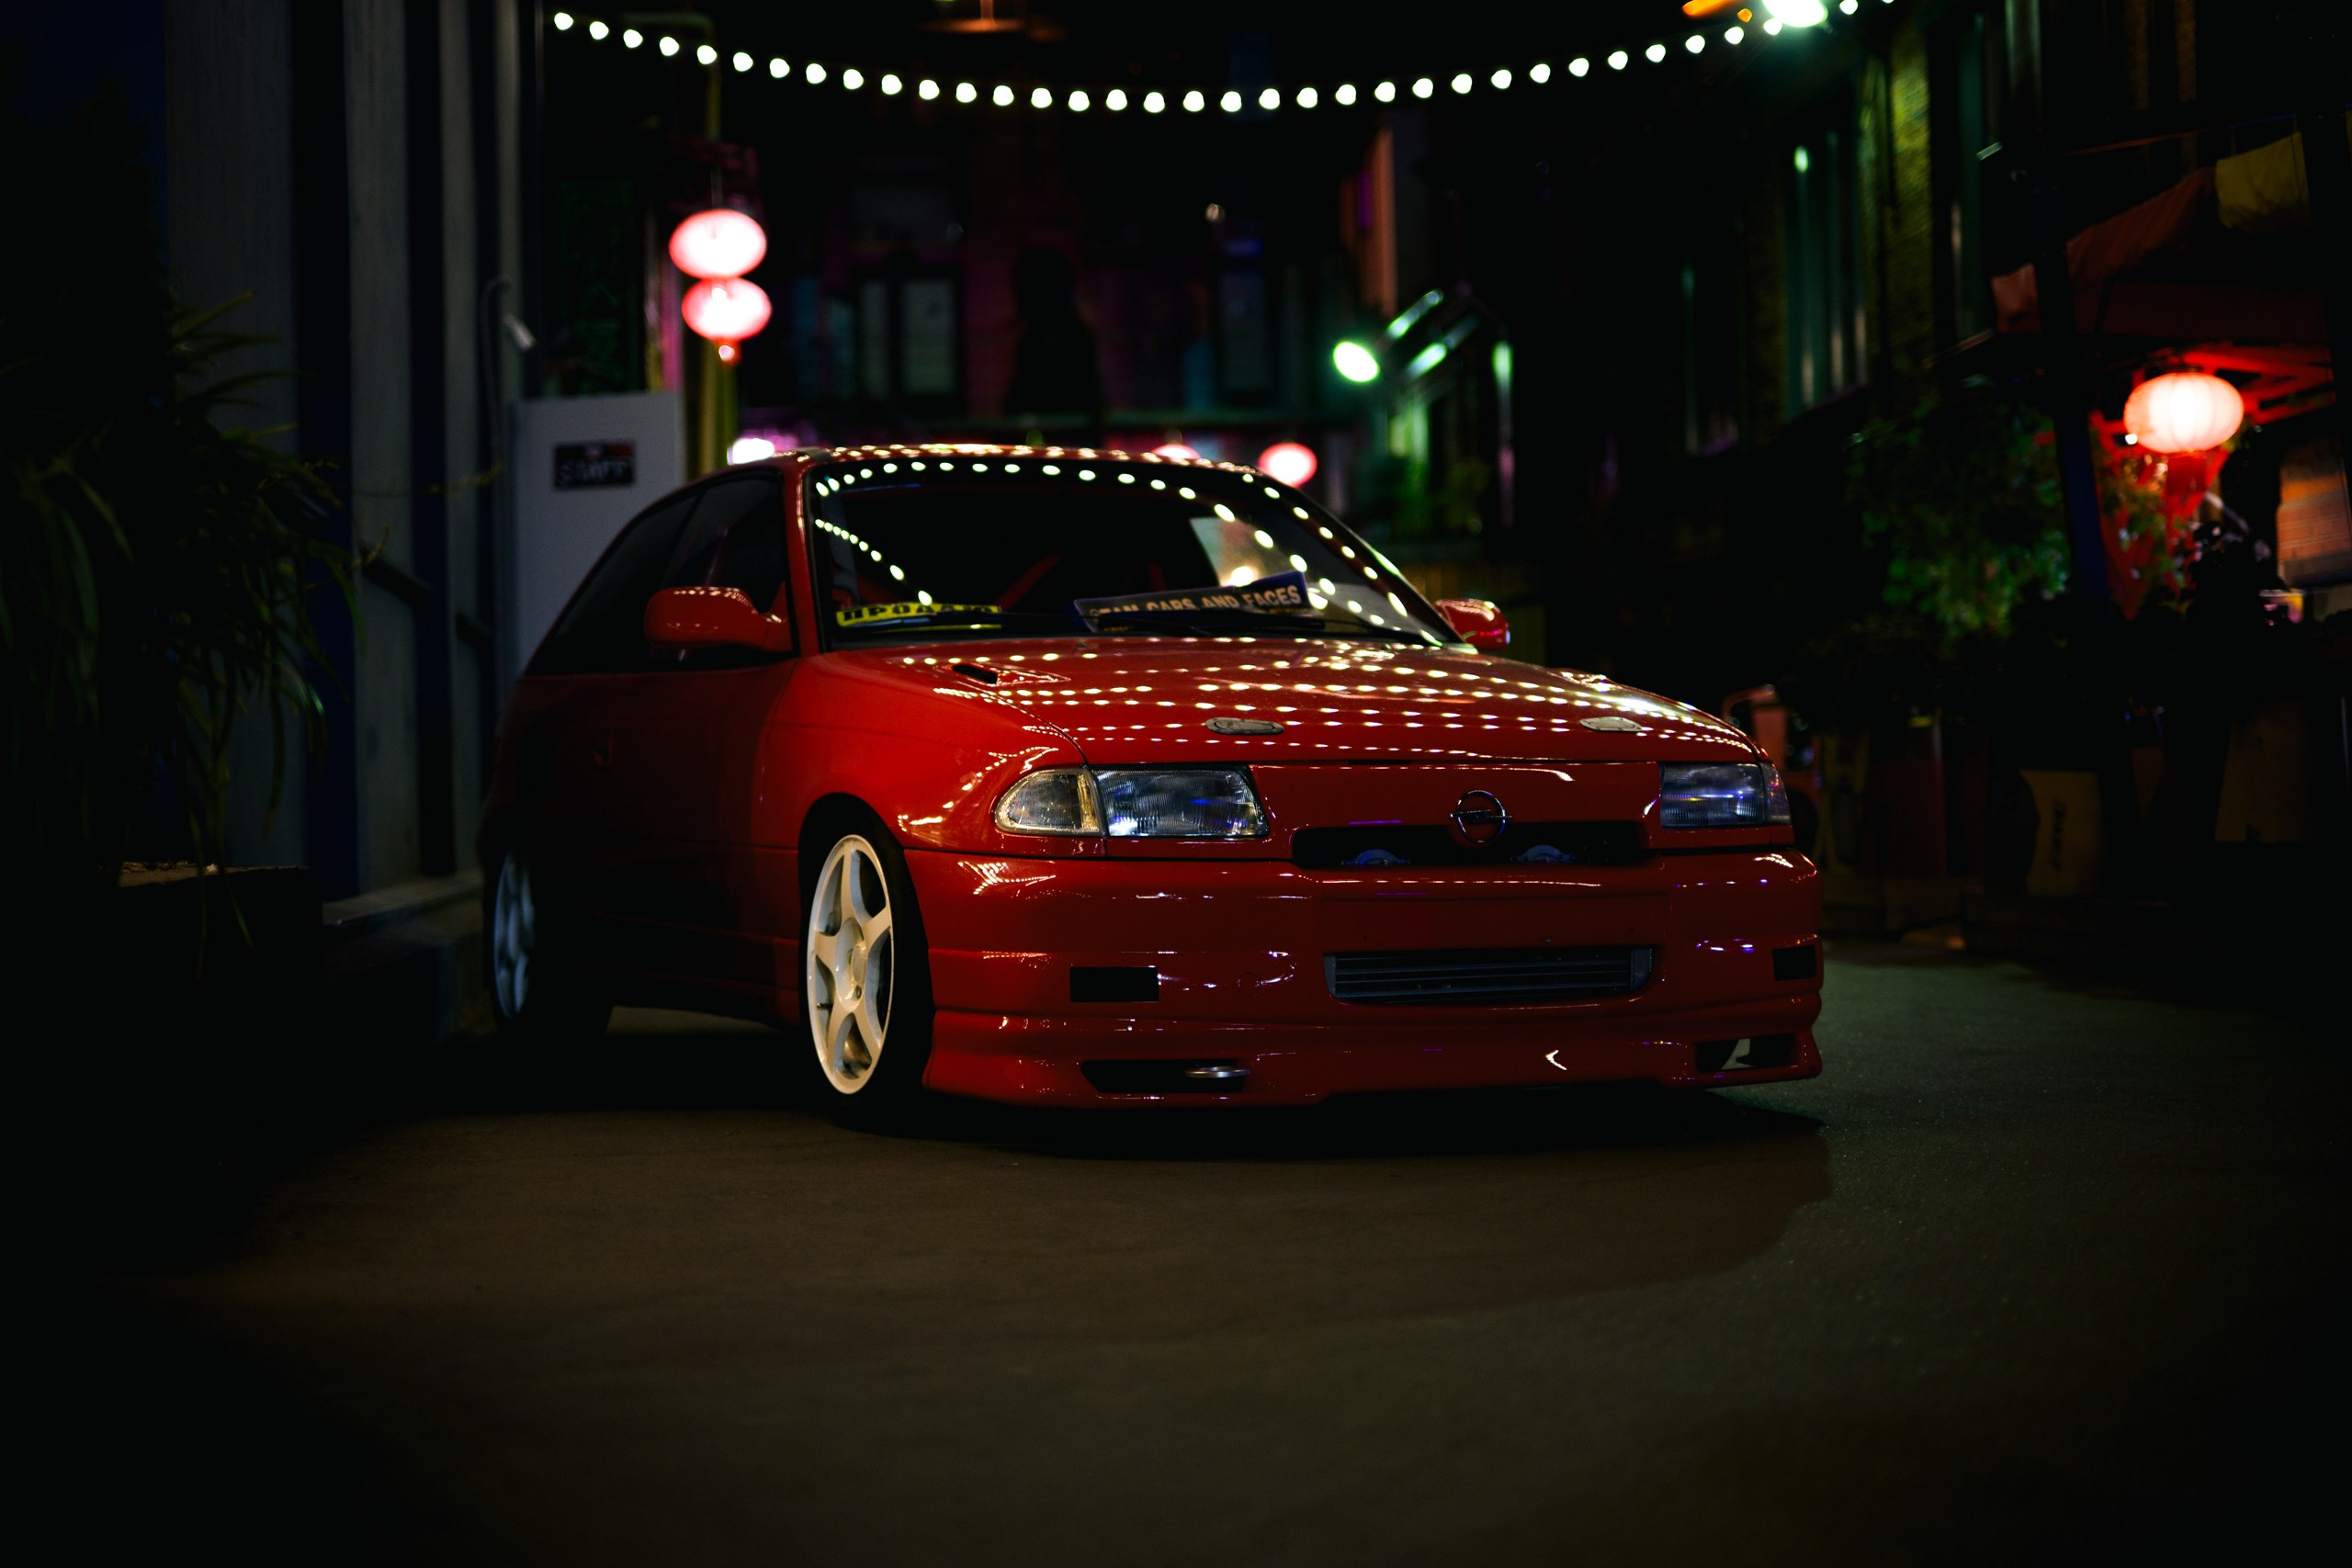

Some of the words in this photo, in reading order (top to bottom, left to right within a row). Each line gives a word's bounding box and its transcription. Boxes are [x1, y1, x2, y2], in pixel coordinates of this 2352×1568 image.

[1146, 598, 1198, 611] CARS
[1201, 595, 1241, 608] AND
[1240, 584, 1302, 607] FACES
